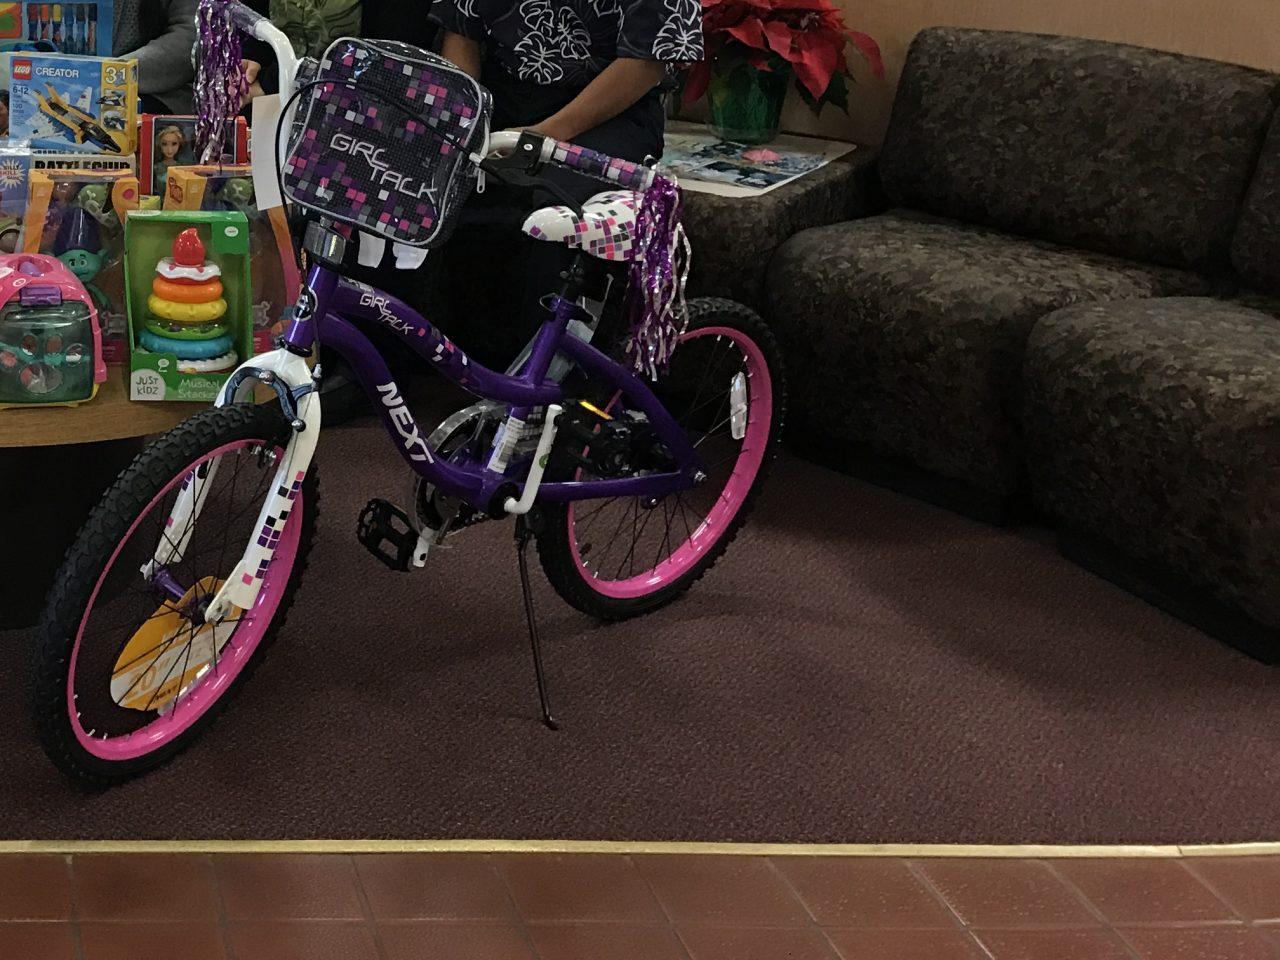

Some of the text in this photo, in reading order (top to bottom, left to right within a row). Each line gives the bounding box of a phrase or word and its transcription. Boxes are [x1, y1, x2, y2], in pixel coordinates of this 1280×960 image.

[14, 64, 80, 79] LEGO CREATOR
[12, 86, 29, 95] 6-12
[329, 133, 389, 168] GIRL
[369, 166, 438, 205] TALK
[360, 292, 392, 315] GIRL
[378, 312, 414, 336] TALK
[135, 375, 159, 386] JUST
[179, 378, 220, 388] Musical
[137, 386, 159, 396] KIDZ
[376, 381, 435, 464] NEXT
